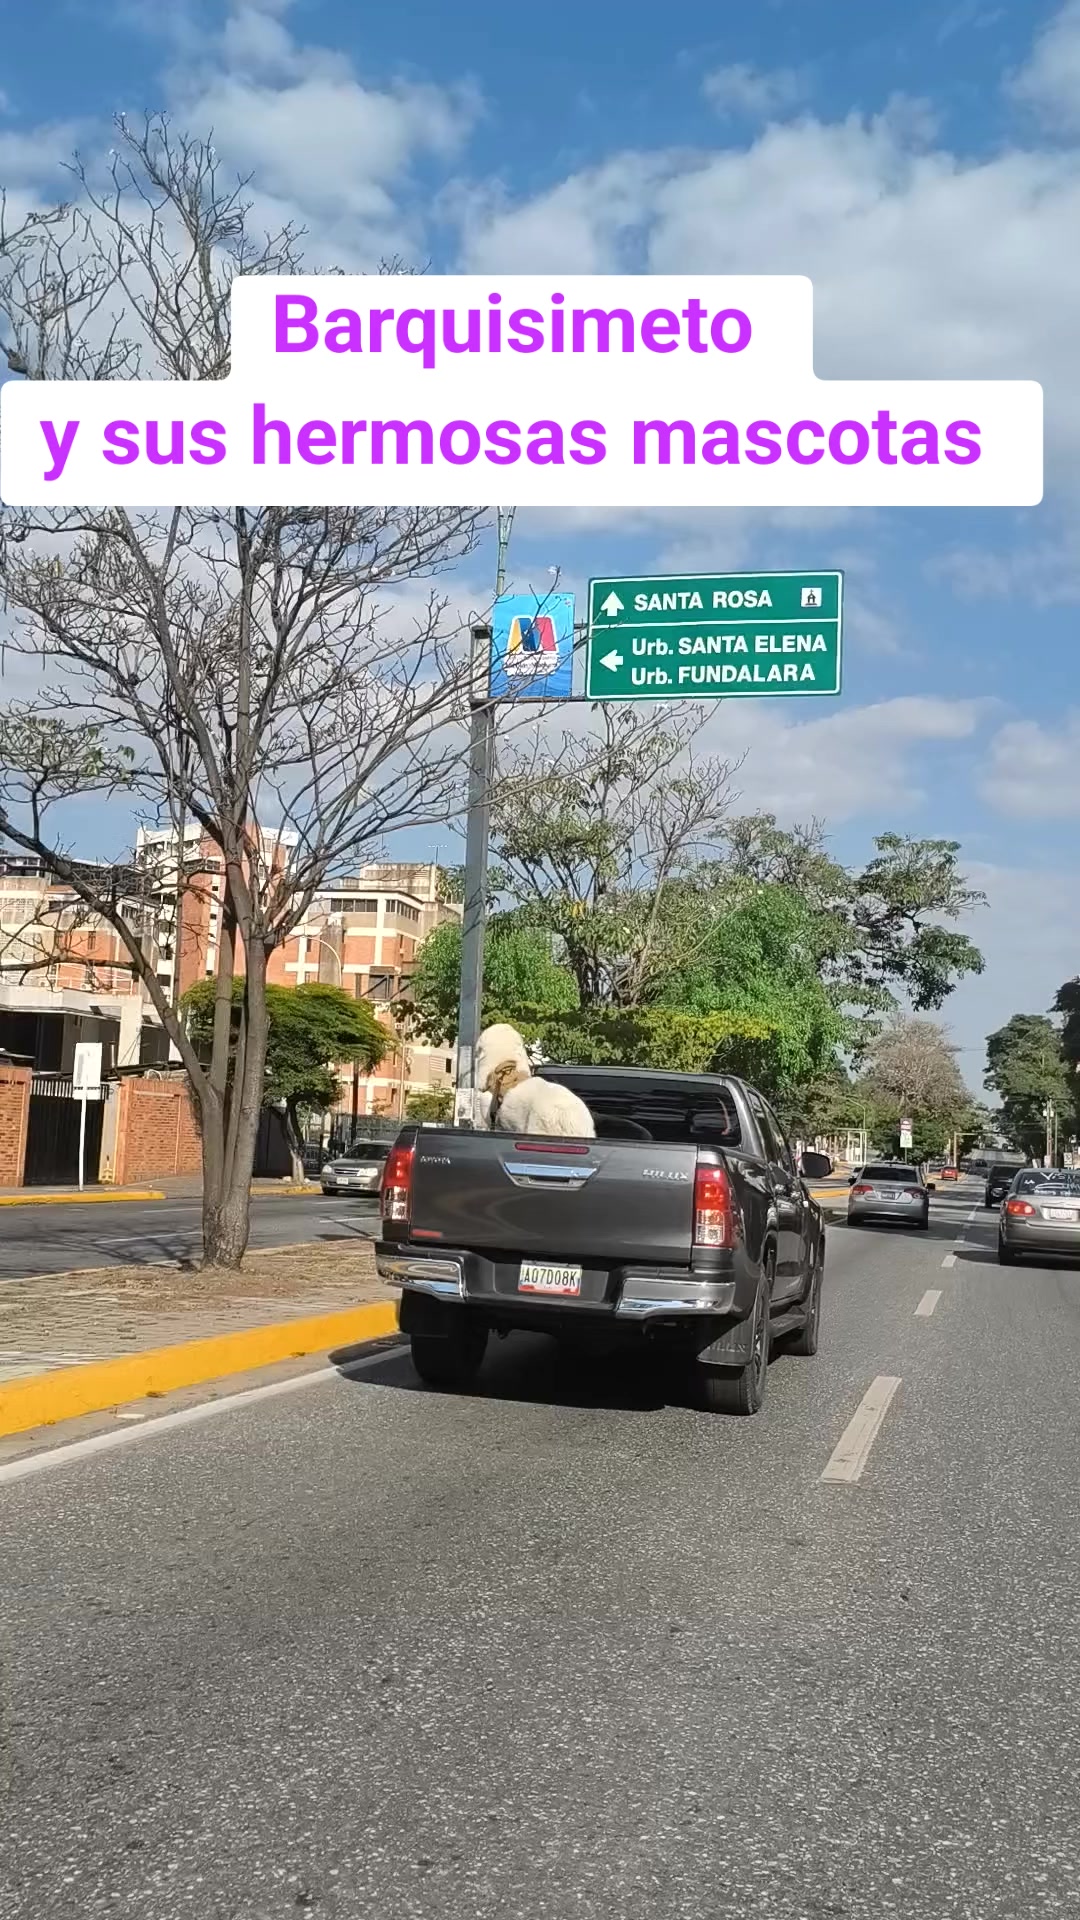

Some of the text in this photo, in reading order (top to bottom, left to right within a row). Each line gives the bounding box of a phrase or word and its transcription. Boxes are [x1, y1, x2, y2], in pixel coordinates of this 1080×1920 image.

[634, 590, 772, 611] SANTA ROSA
[632, 634, 827, 655] Urb. SANTA ELENA
[632, 664, 815, 685] Urb. FUNDALARA
[524, 1267, 576, 1287] A07D08K
